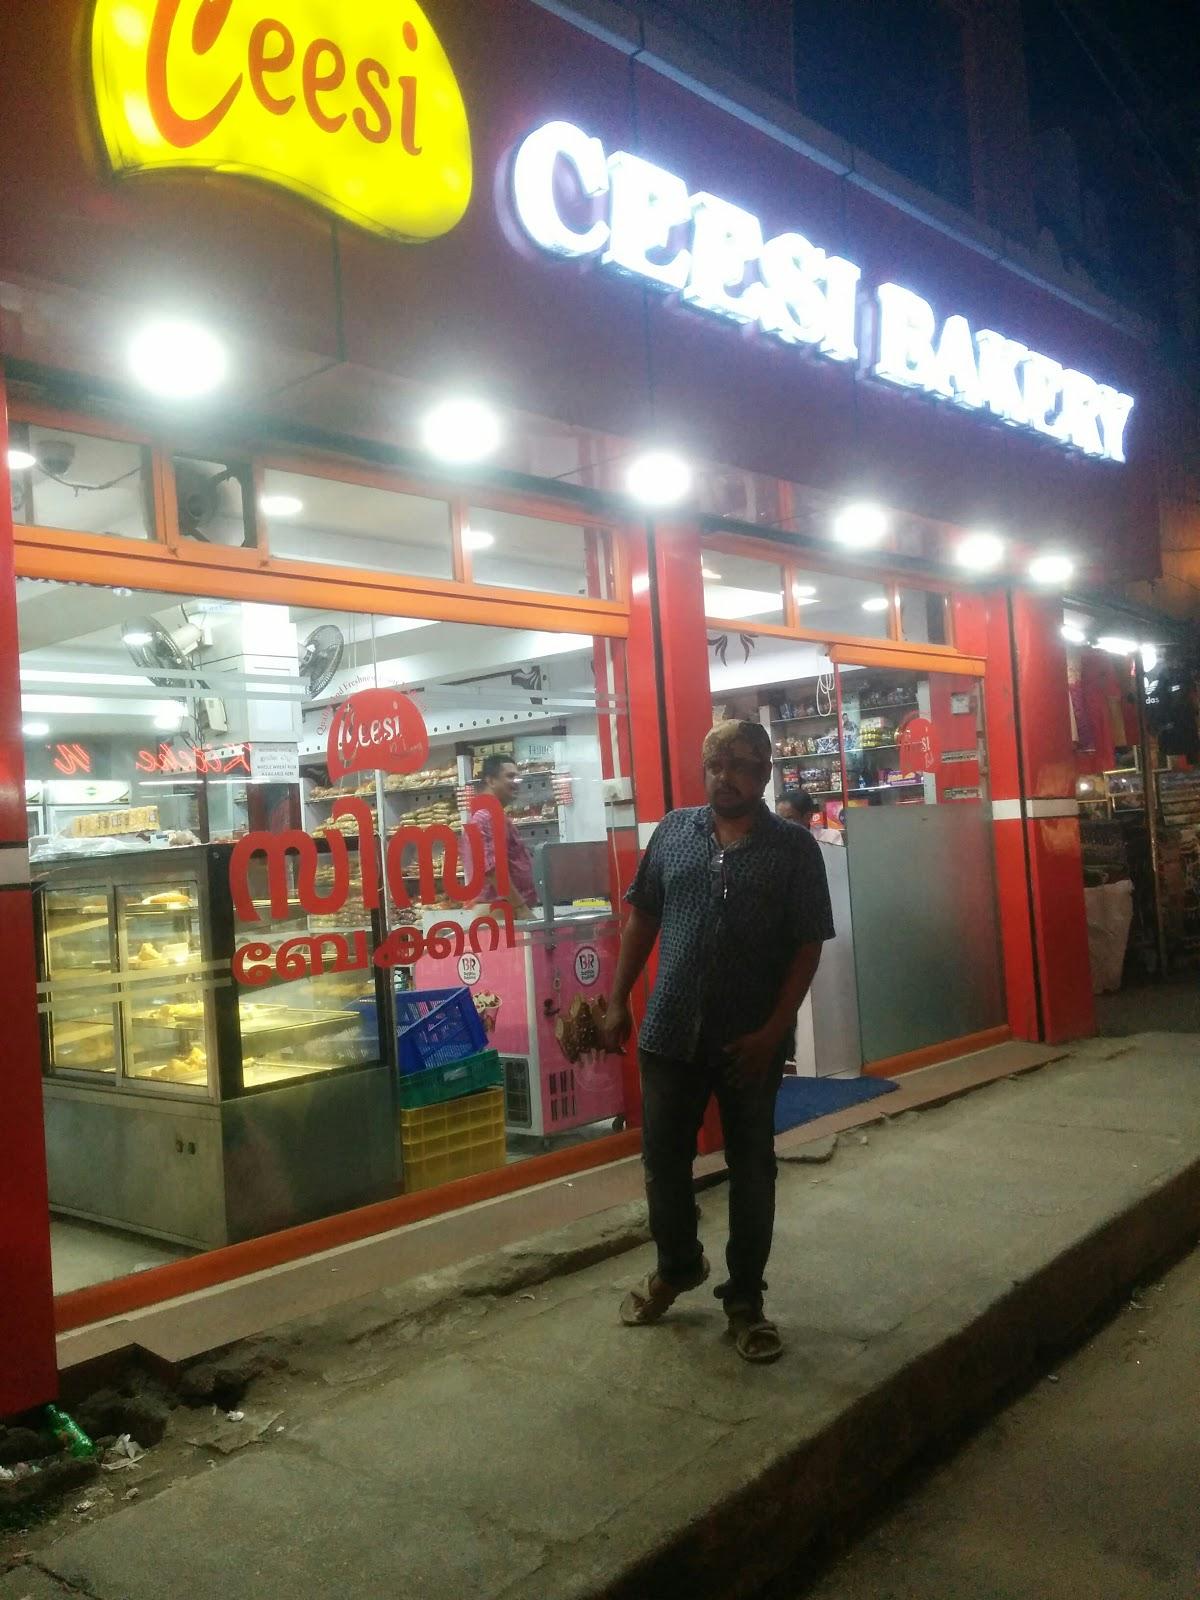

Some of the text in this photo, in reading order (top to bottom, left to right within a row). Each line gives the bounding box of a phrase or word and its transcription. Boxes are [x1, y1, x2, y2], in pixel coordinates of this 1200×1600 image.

[146, 0, 422, 156] Ceesi
[514, 120, 1134, 463] CEESI BAKERY
